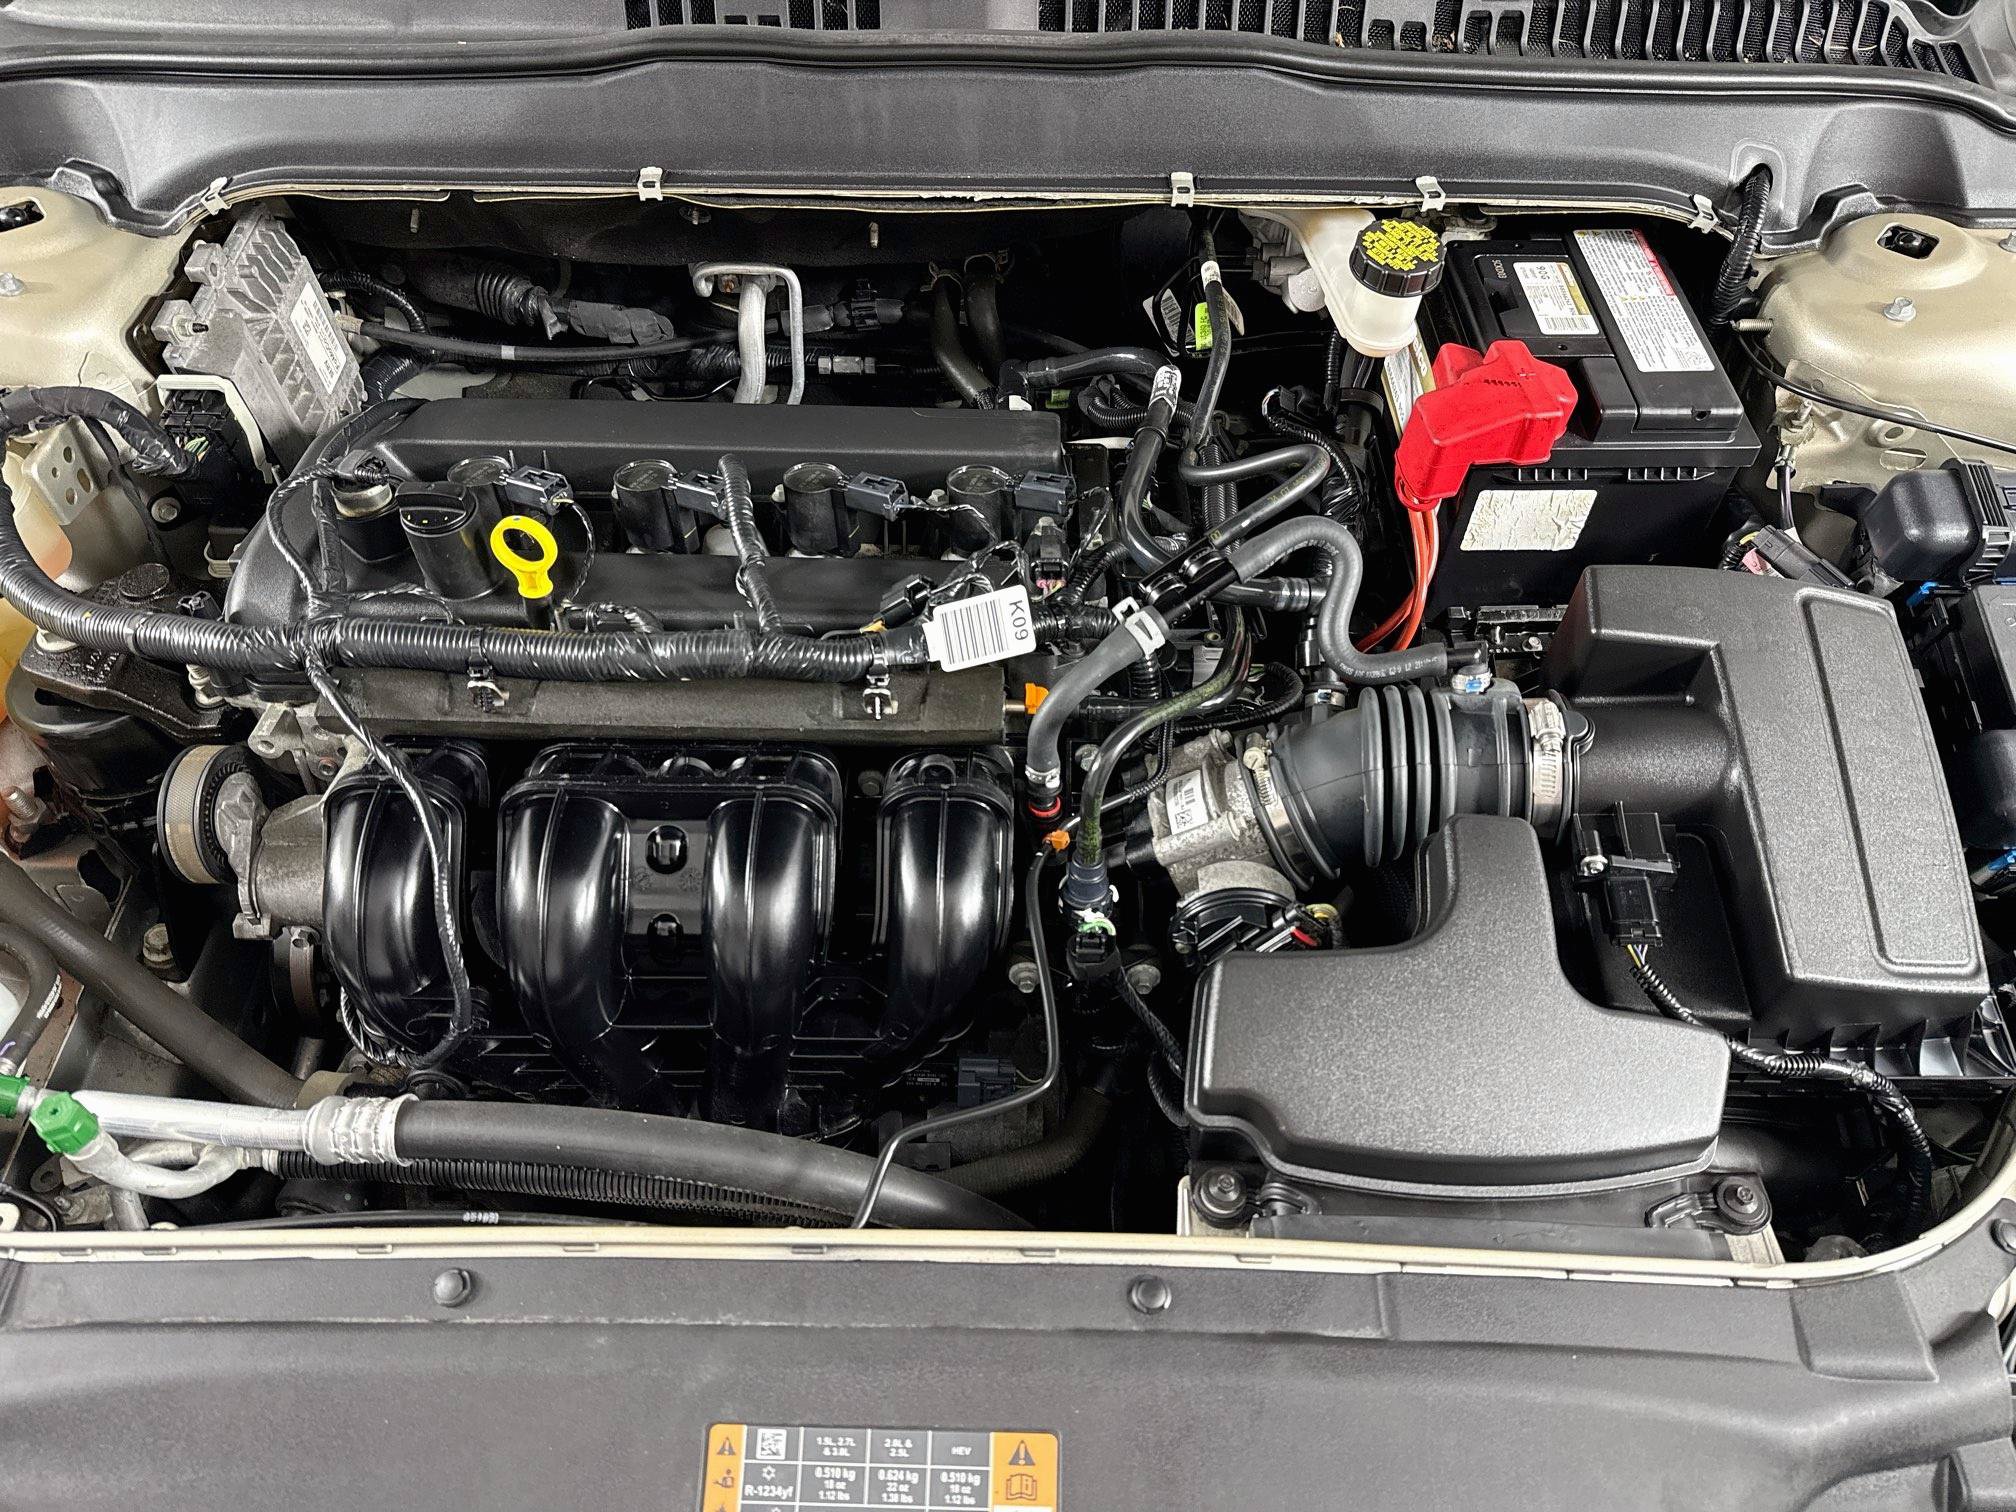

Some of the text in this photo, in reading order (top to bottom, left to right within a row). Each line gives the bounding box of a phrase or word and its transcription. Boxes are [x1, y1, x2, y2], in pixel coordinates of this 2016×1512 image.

[1009, 600, 1028, 640] K09
[842, 1467, 856, 1481] kg
[905, 1470, 919, 1484] kg
[967, 1472, 981, 1486] kg
[744, 1484, 794, 1500] R-1234yf
[886, 1482, 897, 1492] 22
